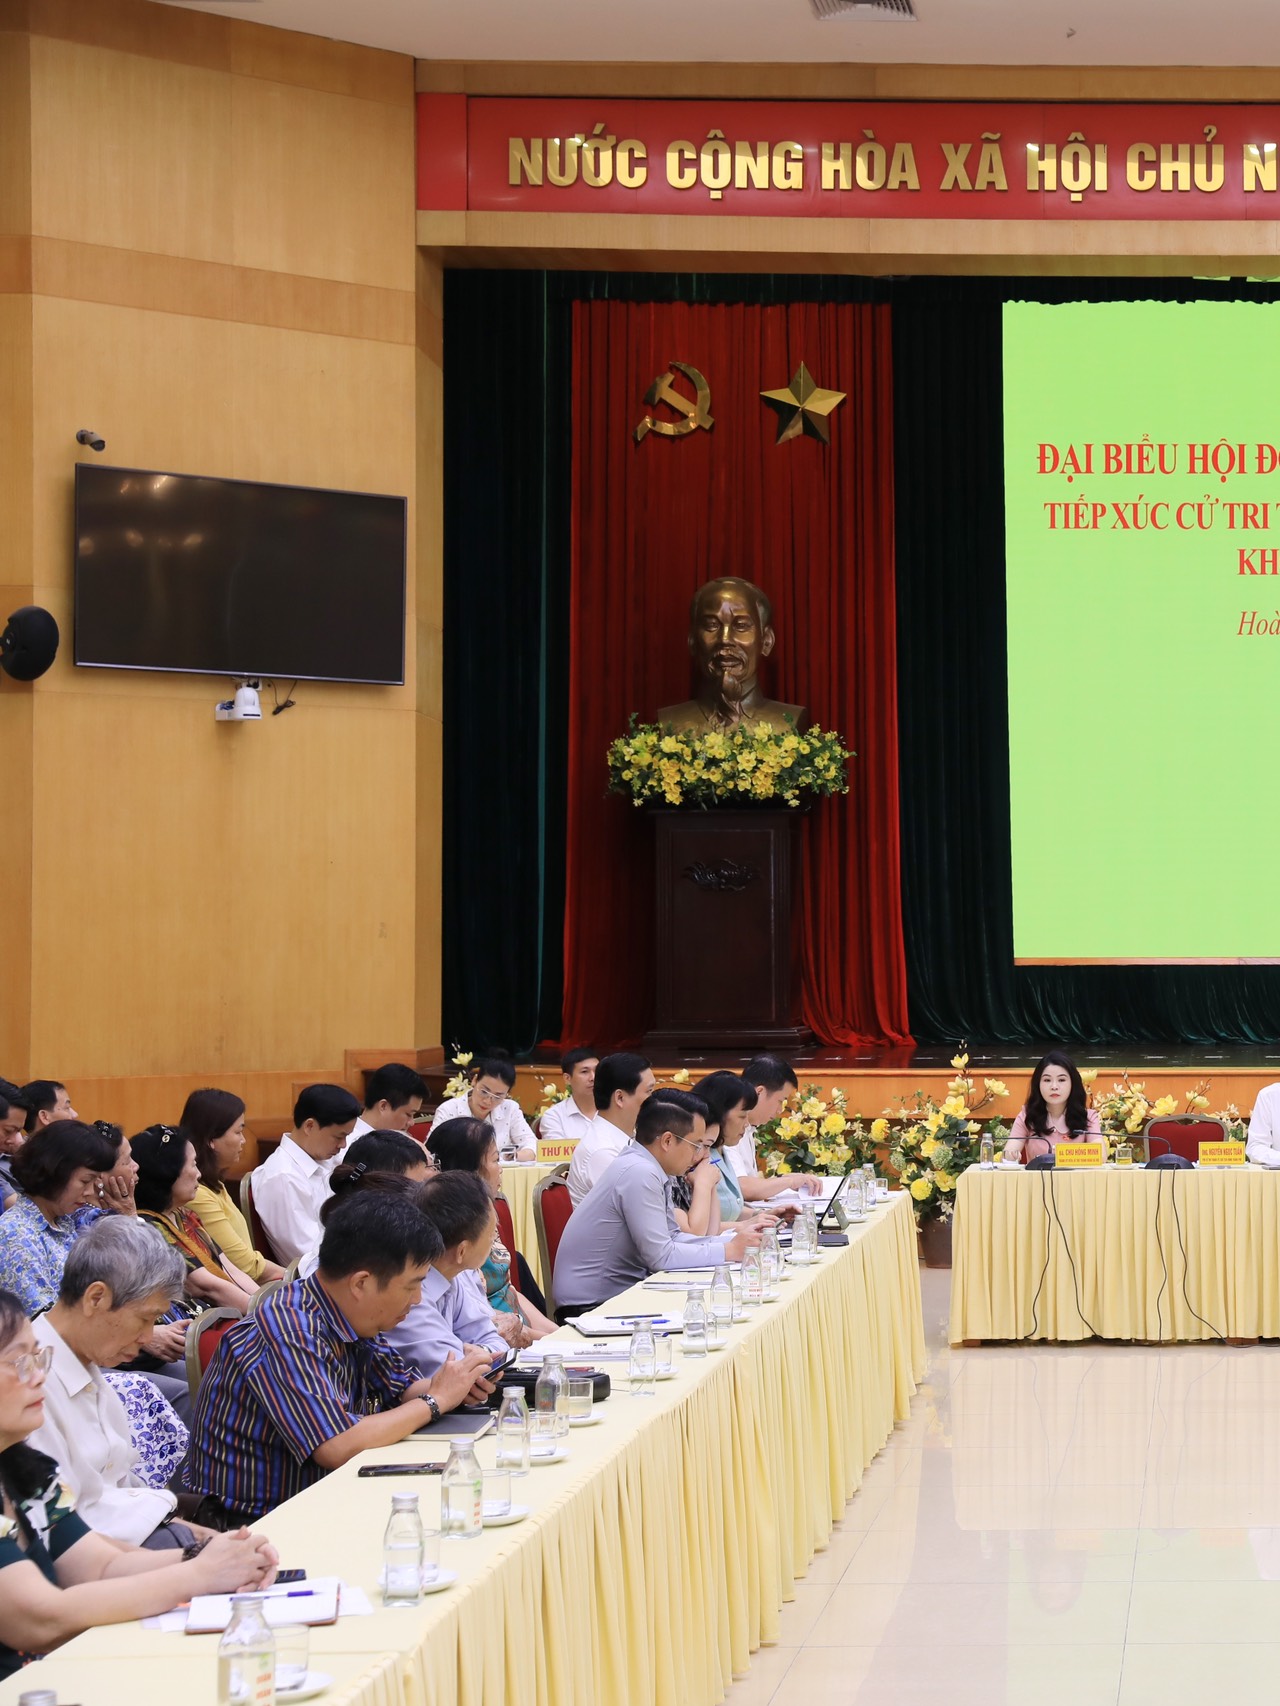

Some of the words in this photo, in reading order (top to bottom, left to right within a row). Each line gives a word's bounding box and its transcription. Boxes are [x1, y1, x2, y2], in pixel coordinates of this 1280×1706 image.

[508, 123, 648, 188] NƯỚC
[666, 129, 804, 200] CỘNG
[821, 130, 921, 190] HÒA
[940, 133, 1009, 191] XÃ
[1027, 132, 1108, 202] HỘI
[1126, 124, 1225, 192] CHỦ
[1036, 442, 1095, 483] ĐẠI
[1102, 433, 1179, 475] BIỂU
[1187, 437, 1248, 483] HỘI
[1043, 493, 1107, 530] TIẾP
[1110, 494, 1170, 530] XÚC
[1175, 494, 1220, 530] CỬ
[1222, 502, 1270, 530] TRI
[541, 1145, 562, 1157] THƯ
